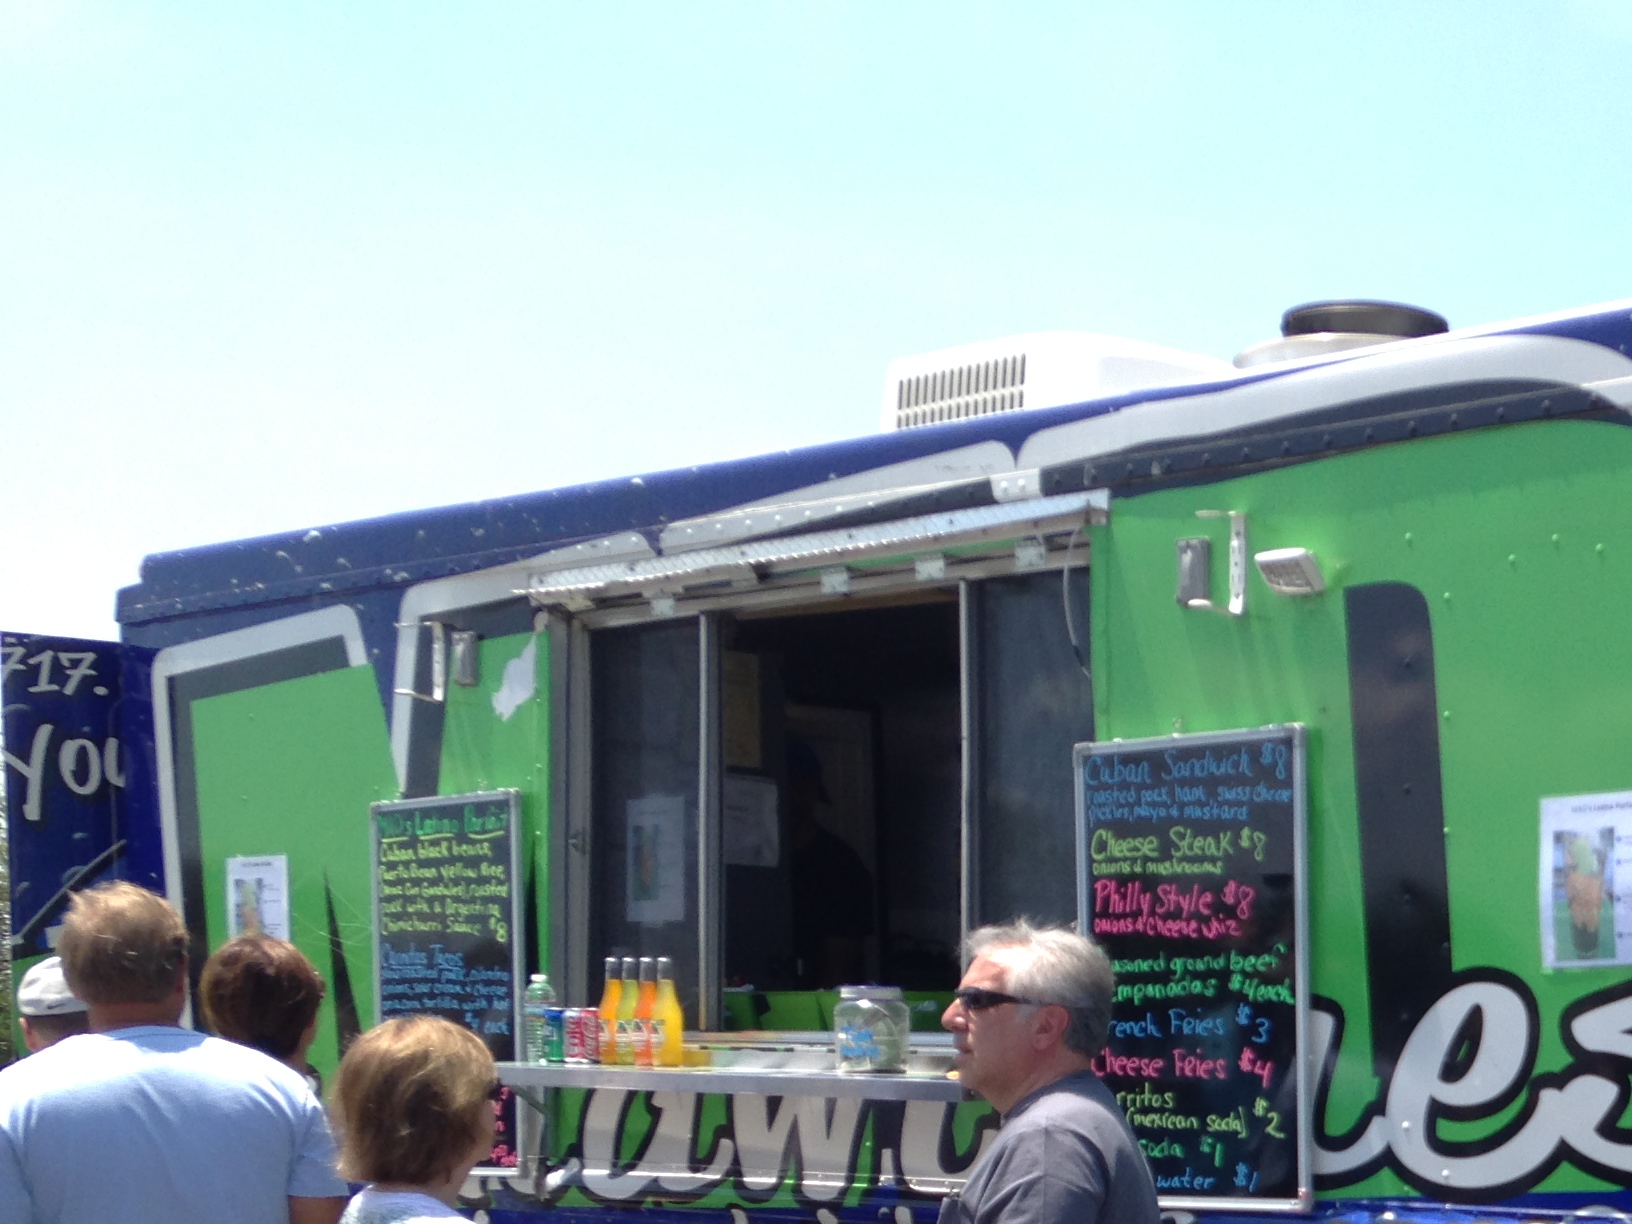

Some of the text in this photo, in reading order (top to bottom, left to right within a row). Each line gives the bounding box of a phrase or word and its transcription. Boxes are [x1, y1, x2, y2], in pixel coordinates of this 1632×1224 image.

[1084, 741, 1288, 785] Cuban Sandwich $8
[1091, 825, 1267, 862] Cheese Steak $8
[1094, 879, 1255, 922] Philly Style $8
[1110, 950, 1165, 974] asoned
[1169, 953, 1226, 980] ground
[1111, 976, 1219, 1006] mpanadas
[1107, 1011, 1162, 1039] rench
[1116, 1081, 1176, 1108] rritos
[1138, 1136, 1185, 1158] soda
[1156, 1167, 1217, 1189] water
